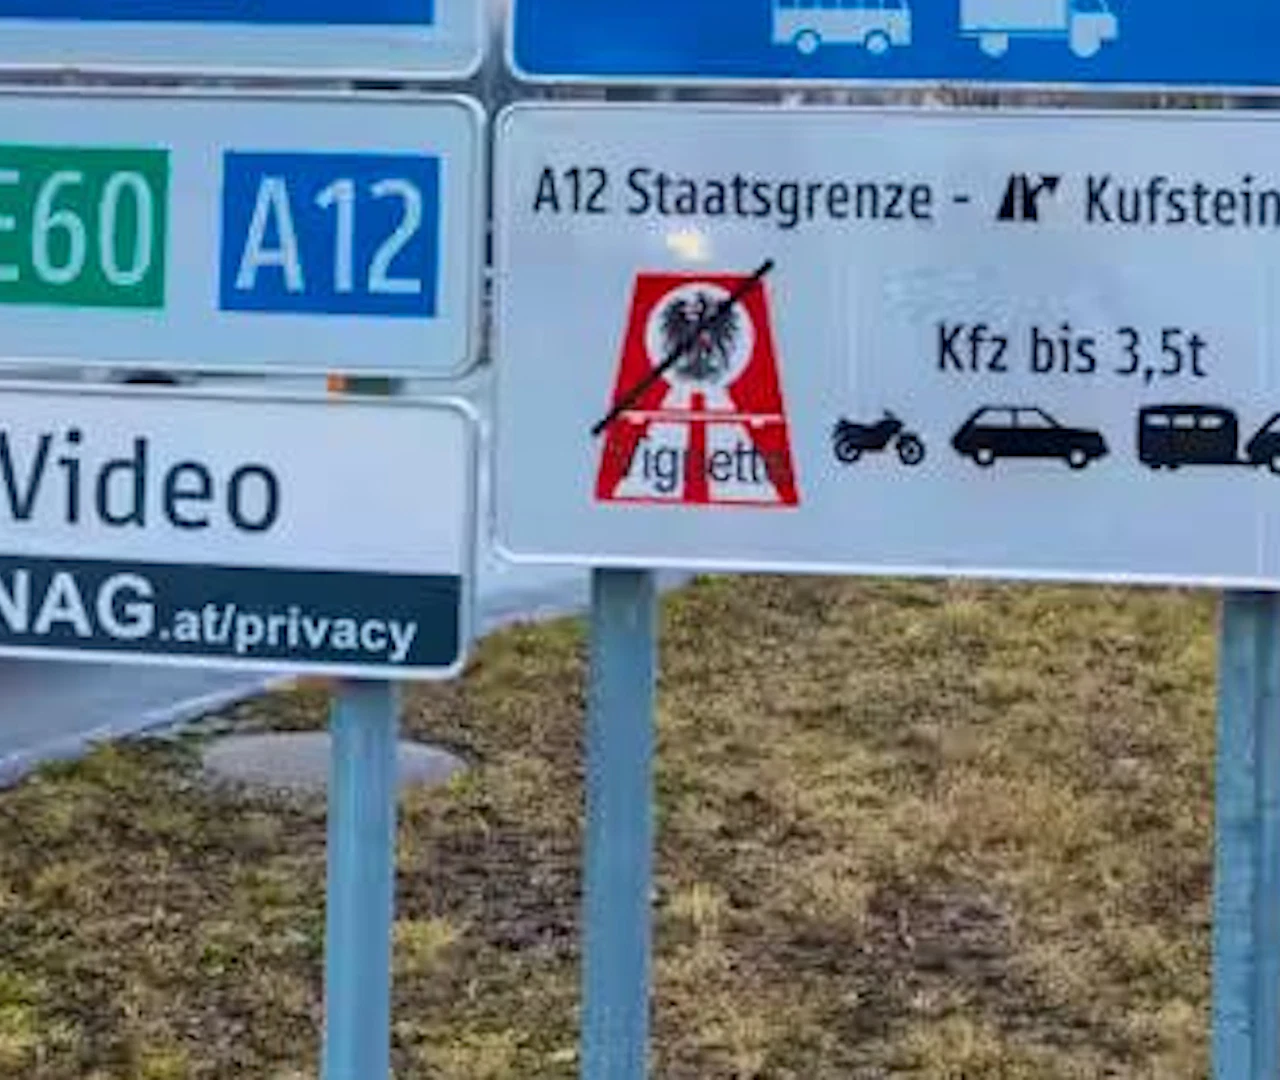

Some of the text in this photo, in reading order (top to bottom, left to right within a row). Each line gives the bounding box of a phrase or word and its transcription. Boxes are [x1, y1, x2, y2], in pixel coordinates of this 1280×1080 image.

[531, 166, 607, 216] A12
[627, 168, 934, 227] Staatsgrenze
[233, 174, 424, 296] A12
[936, 325, 1209, 388] Kfz bis 3,5t
